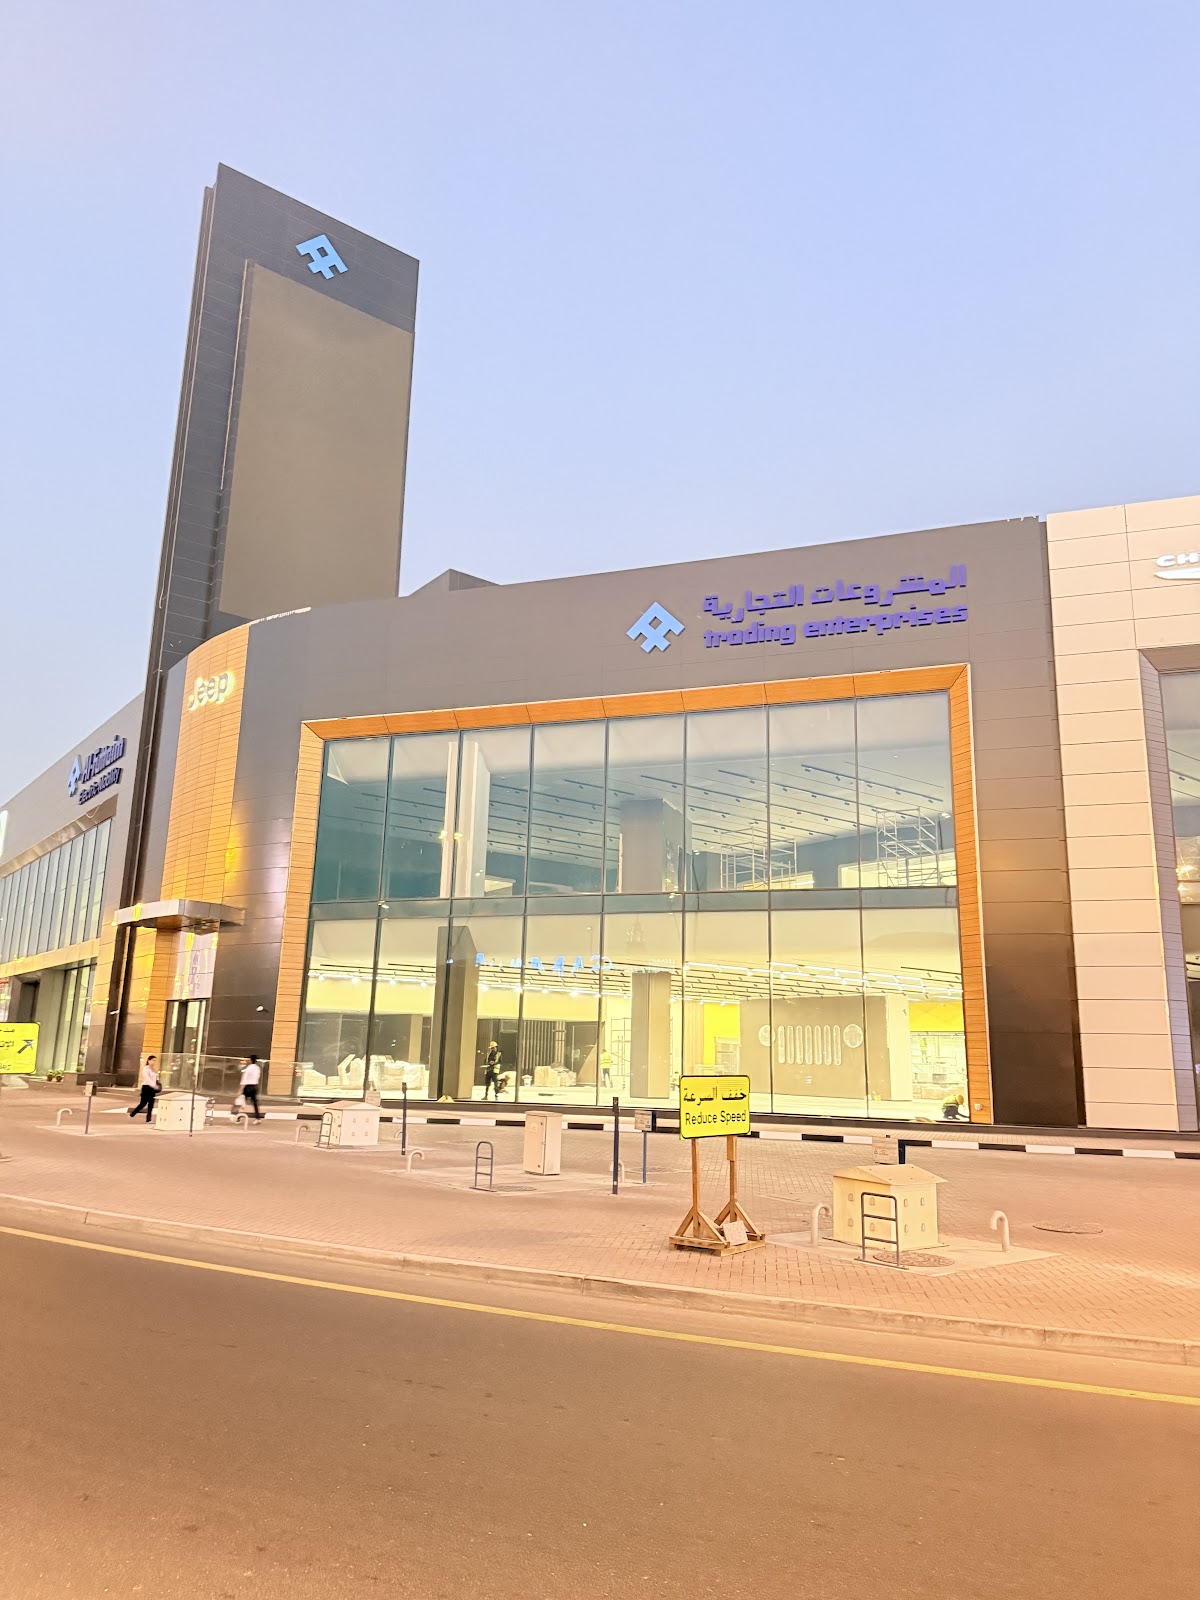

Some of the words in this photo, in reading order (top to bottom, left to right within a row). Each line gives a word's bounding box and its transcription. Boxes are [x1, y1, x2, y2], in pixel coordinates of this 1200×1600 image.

[703, 584, 804, 623] التجارية
[811, 564, 967, 607] المشروعات
[703, 621, 796, 648] trading
[803, 604, 968, 636] enterprises
[188, 672, 233, 711] Jeep
[685, 1111, 718, 1126] Reduce
[720, 1109, 747, 1126] Speed
